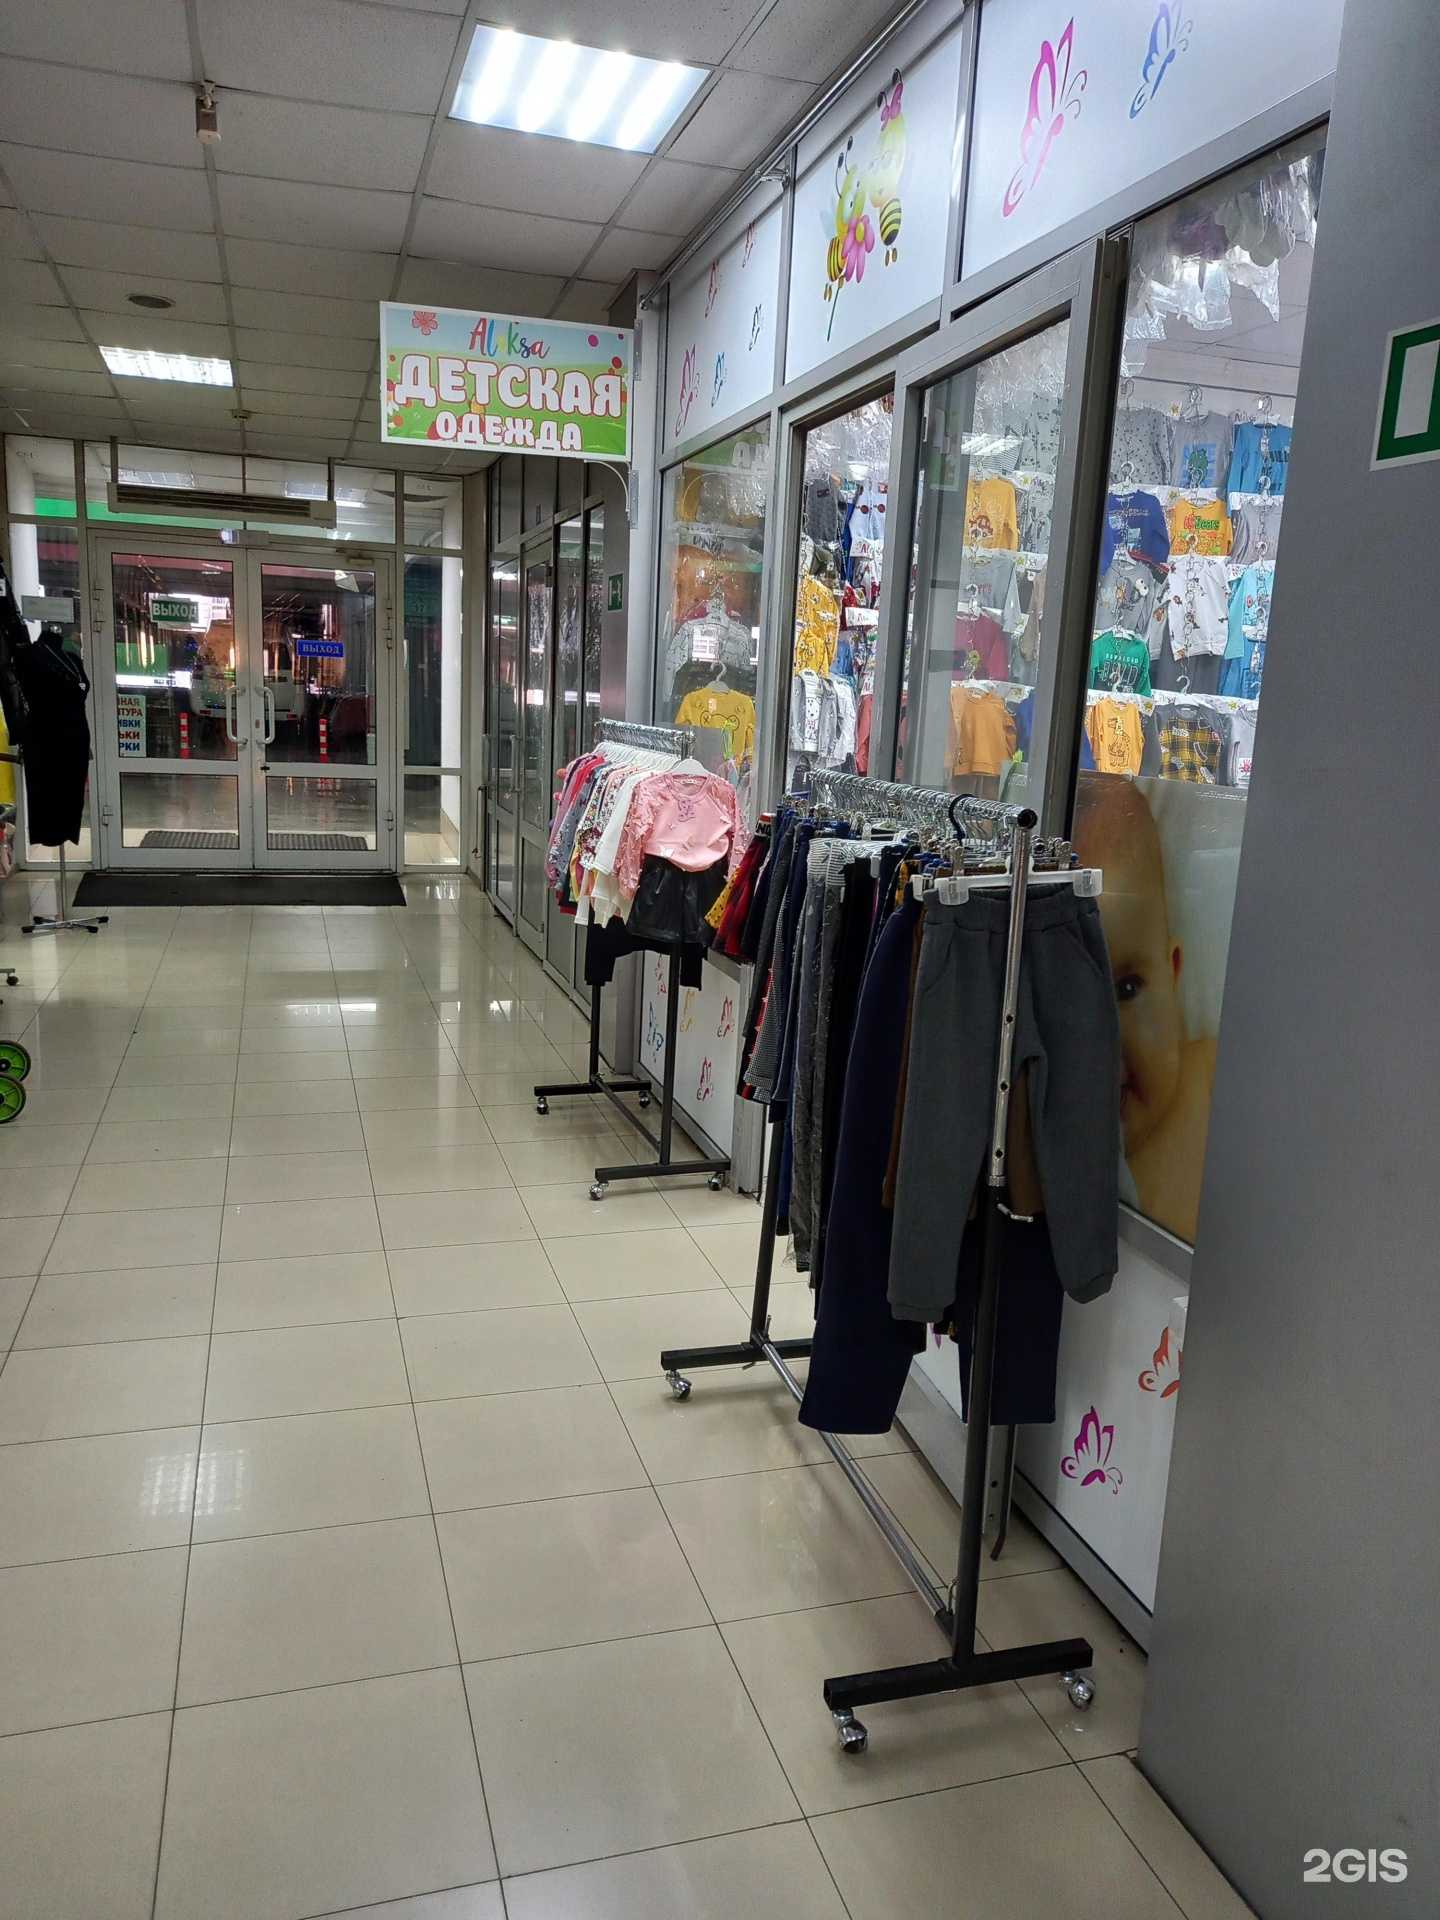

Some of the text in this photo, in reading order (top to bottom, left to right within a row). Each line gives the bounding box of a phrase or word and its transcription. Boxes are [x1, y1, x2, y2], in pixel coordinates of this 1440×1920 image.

[394, 354, 622, 418] ДЕТСКАЯ
[436, 410, 583, 451] ОДЕЖДА
[152, 602, 198, 619] ВЫХОД
[303, 643, 340, 655] ВЫХОД
